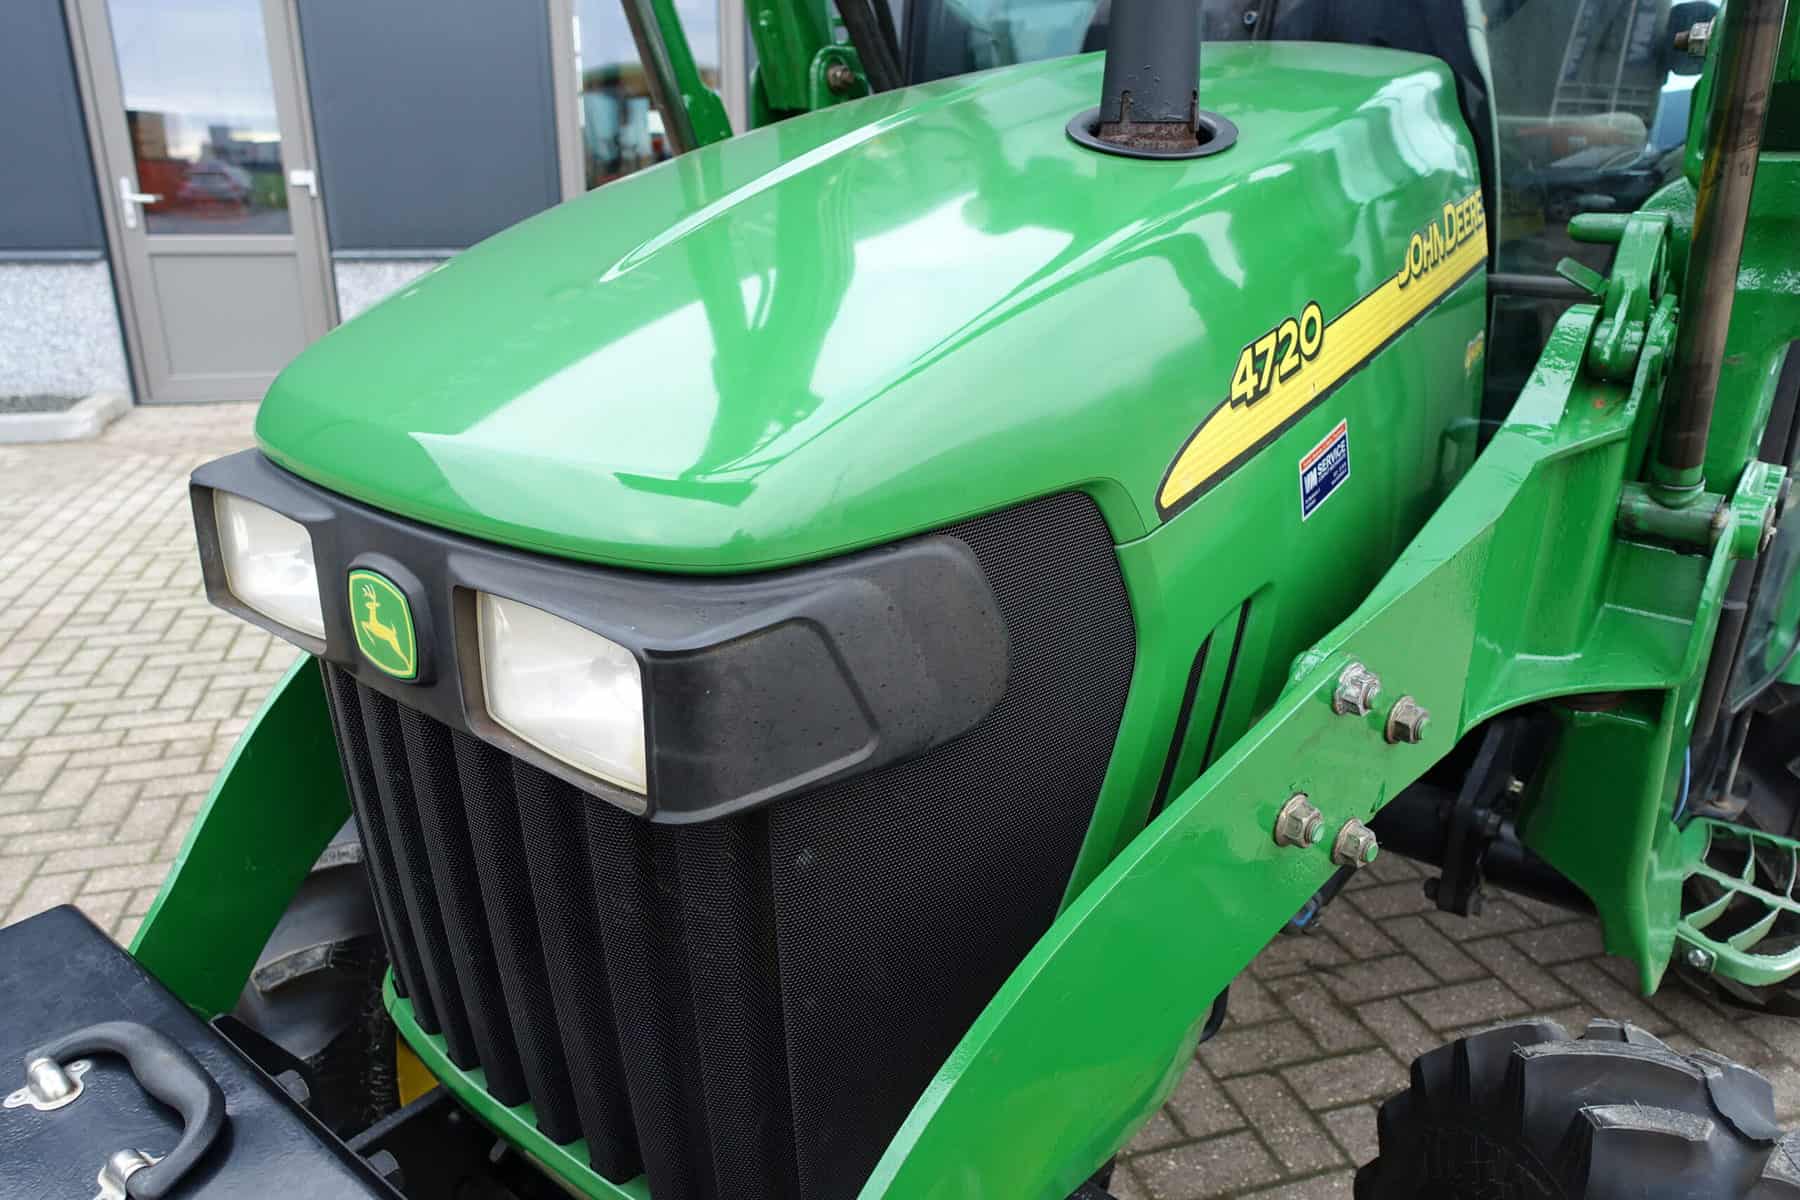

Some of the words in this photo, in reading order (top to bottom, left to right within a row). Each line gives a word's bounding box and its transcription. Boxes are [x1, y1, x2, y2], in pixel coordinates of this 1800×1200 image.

[1398, 220, 1445, 288] JOHN
[1443, 189, 1485, 256] DEERE
[1230, 300, 1323, 408] 4720
[1317, 438, 1346, 476] SERVICE
